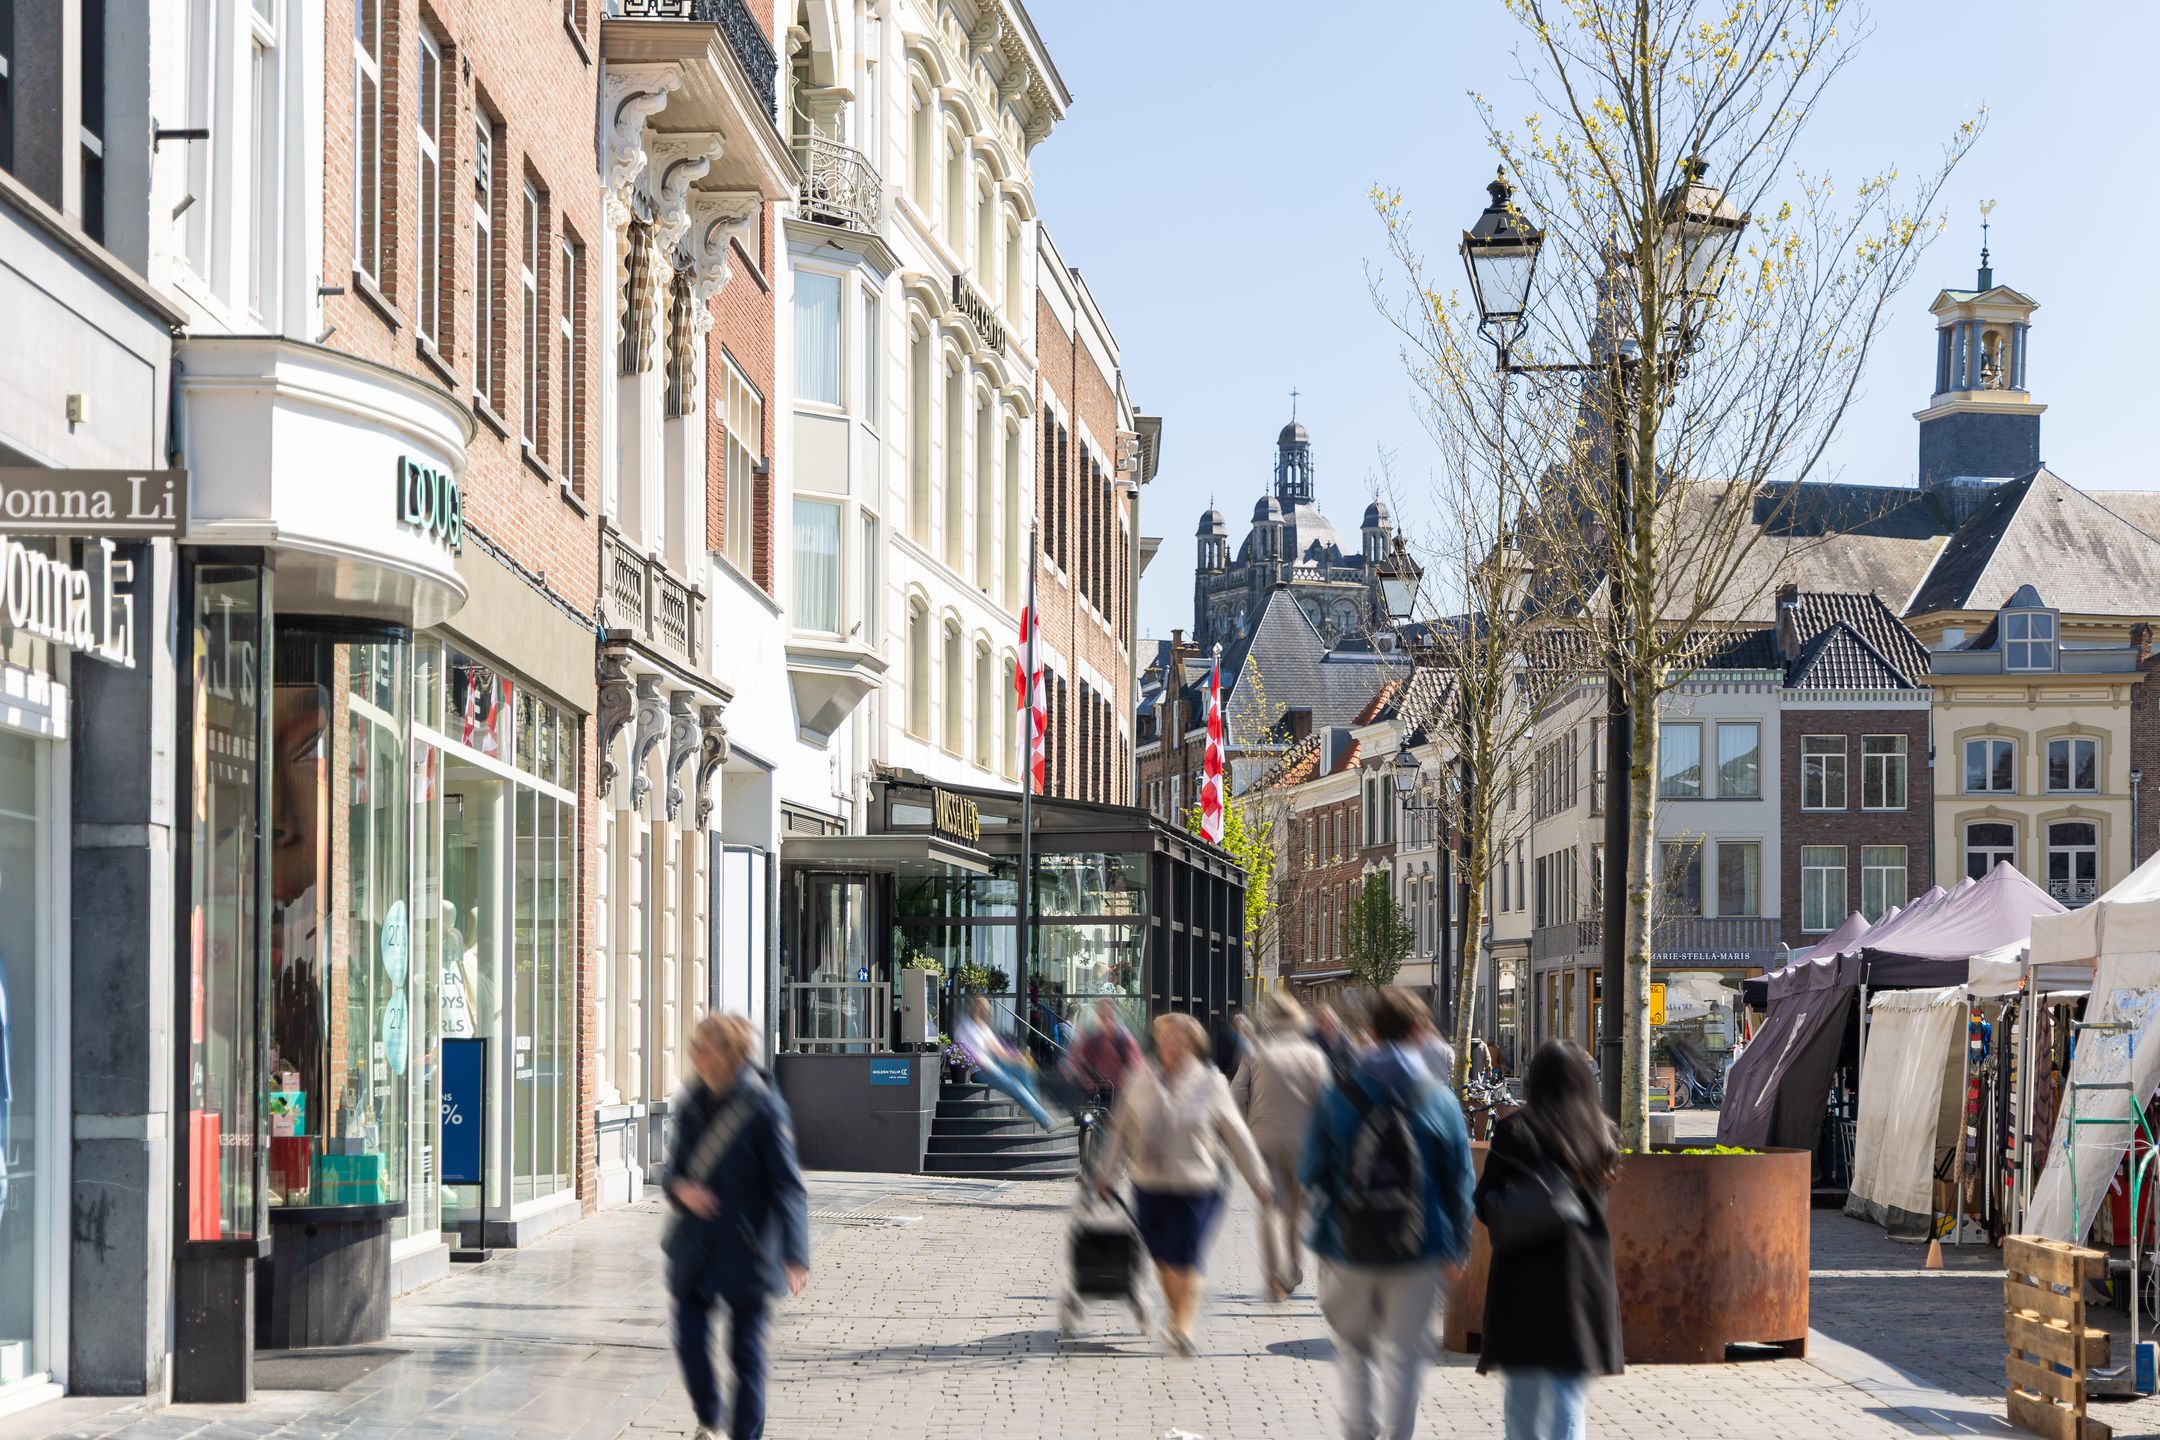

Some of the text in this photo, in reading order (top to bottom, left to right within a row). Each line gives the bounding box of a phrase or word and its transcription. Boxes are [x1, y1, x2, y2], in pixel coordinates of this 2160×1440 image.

[0, 477, 176, 519] onna Li
[397, 456, 461, 551] DOUG
[0, 534, 136, 669] onna Li
[441, 973, 464, 985] EN
[441, 996, 464, 1009] YS
[441, 1020, 464, 1033] RLS
[441, 1093, 453, 1102] NS
